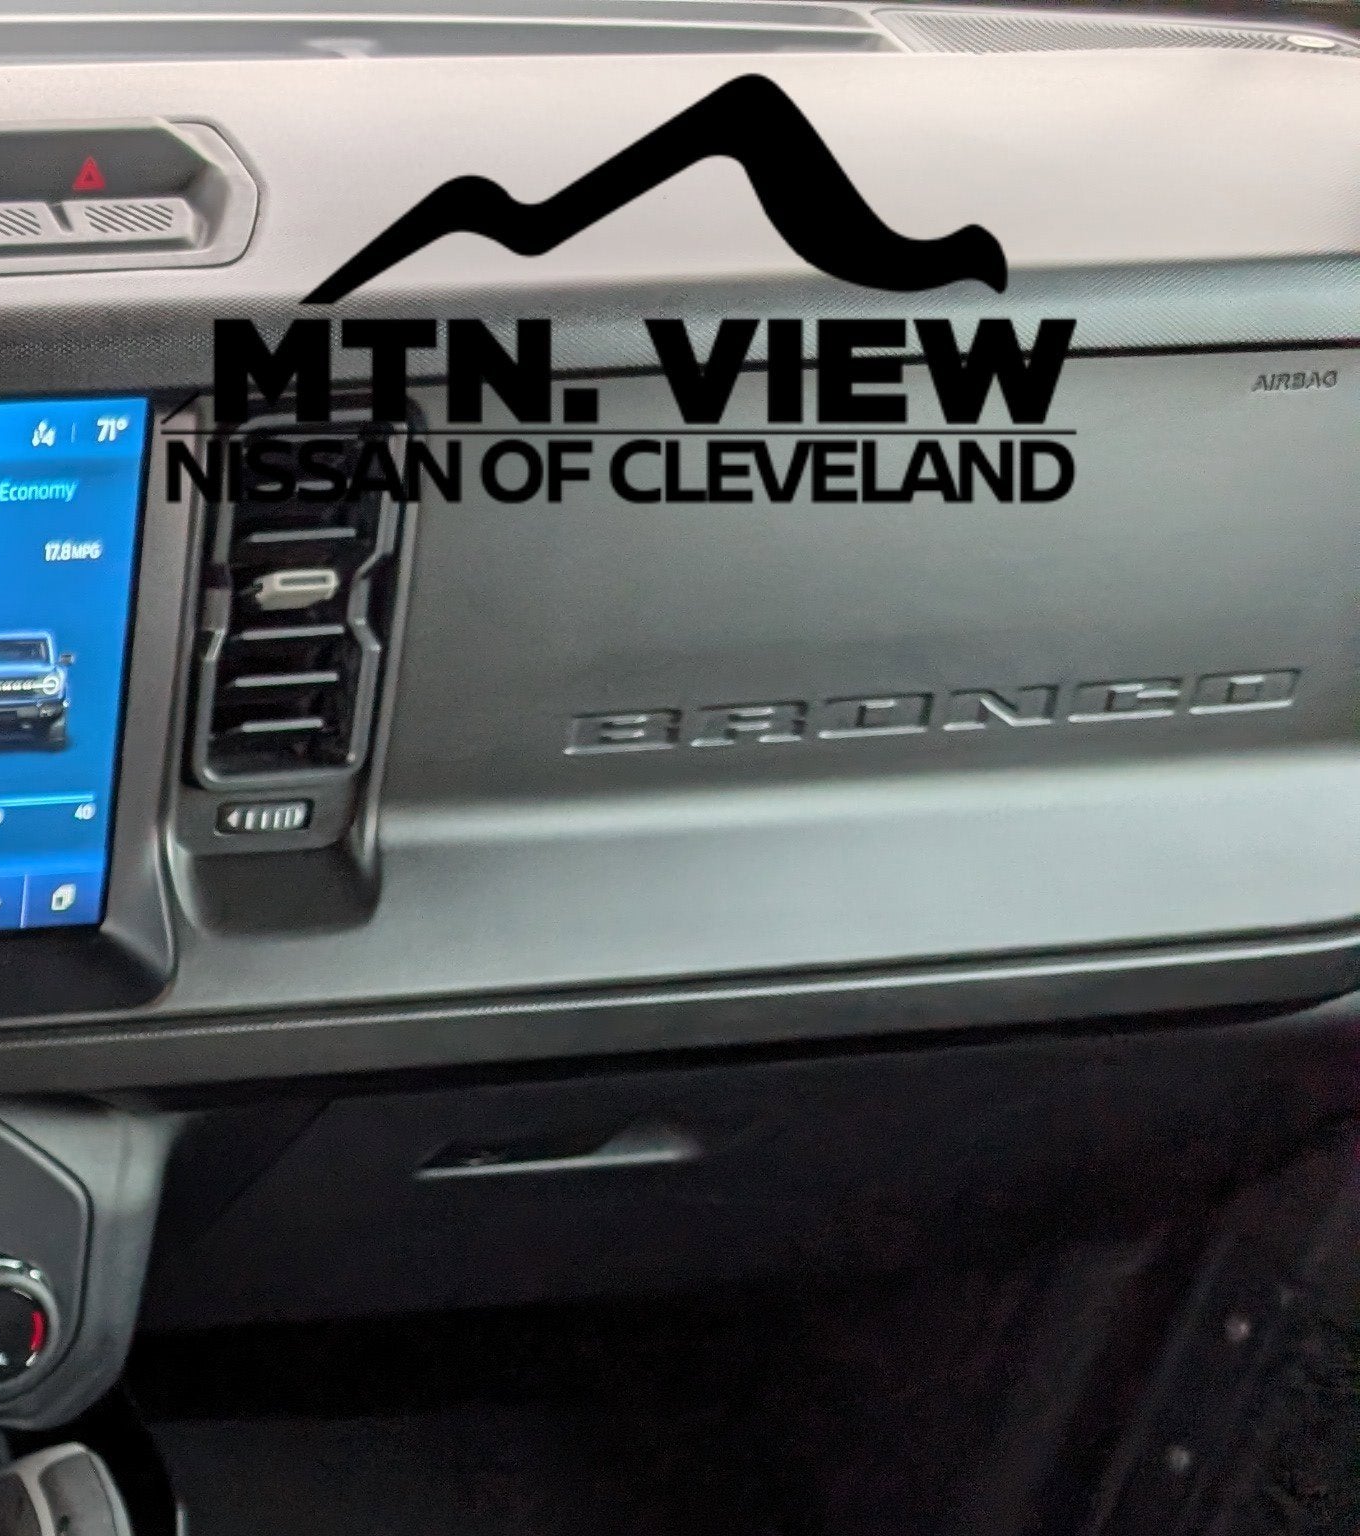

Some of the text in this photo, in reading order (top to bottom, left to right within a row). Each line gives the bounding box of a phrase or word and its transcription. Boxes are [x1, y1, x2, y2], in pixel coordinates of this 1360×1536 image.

[1251, 370, 1338, 392] AIRBAG
[563, 668, 1302, 755] BRONCO
[75, 803, 97, 820] 40
